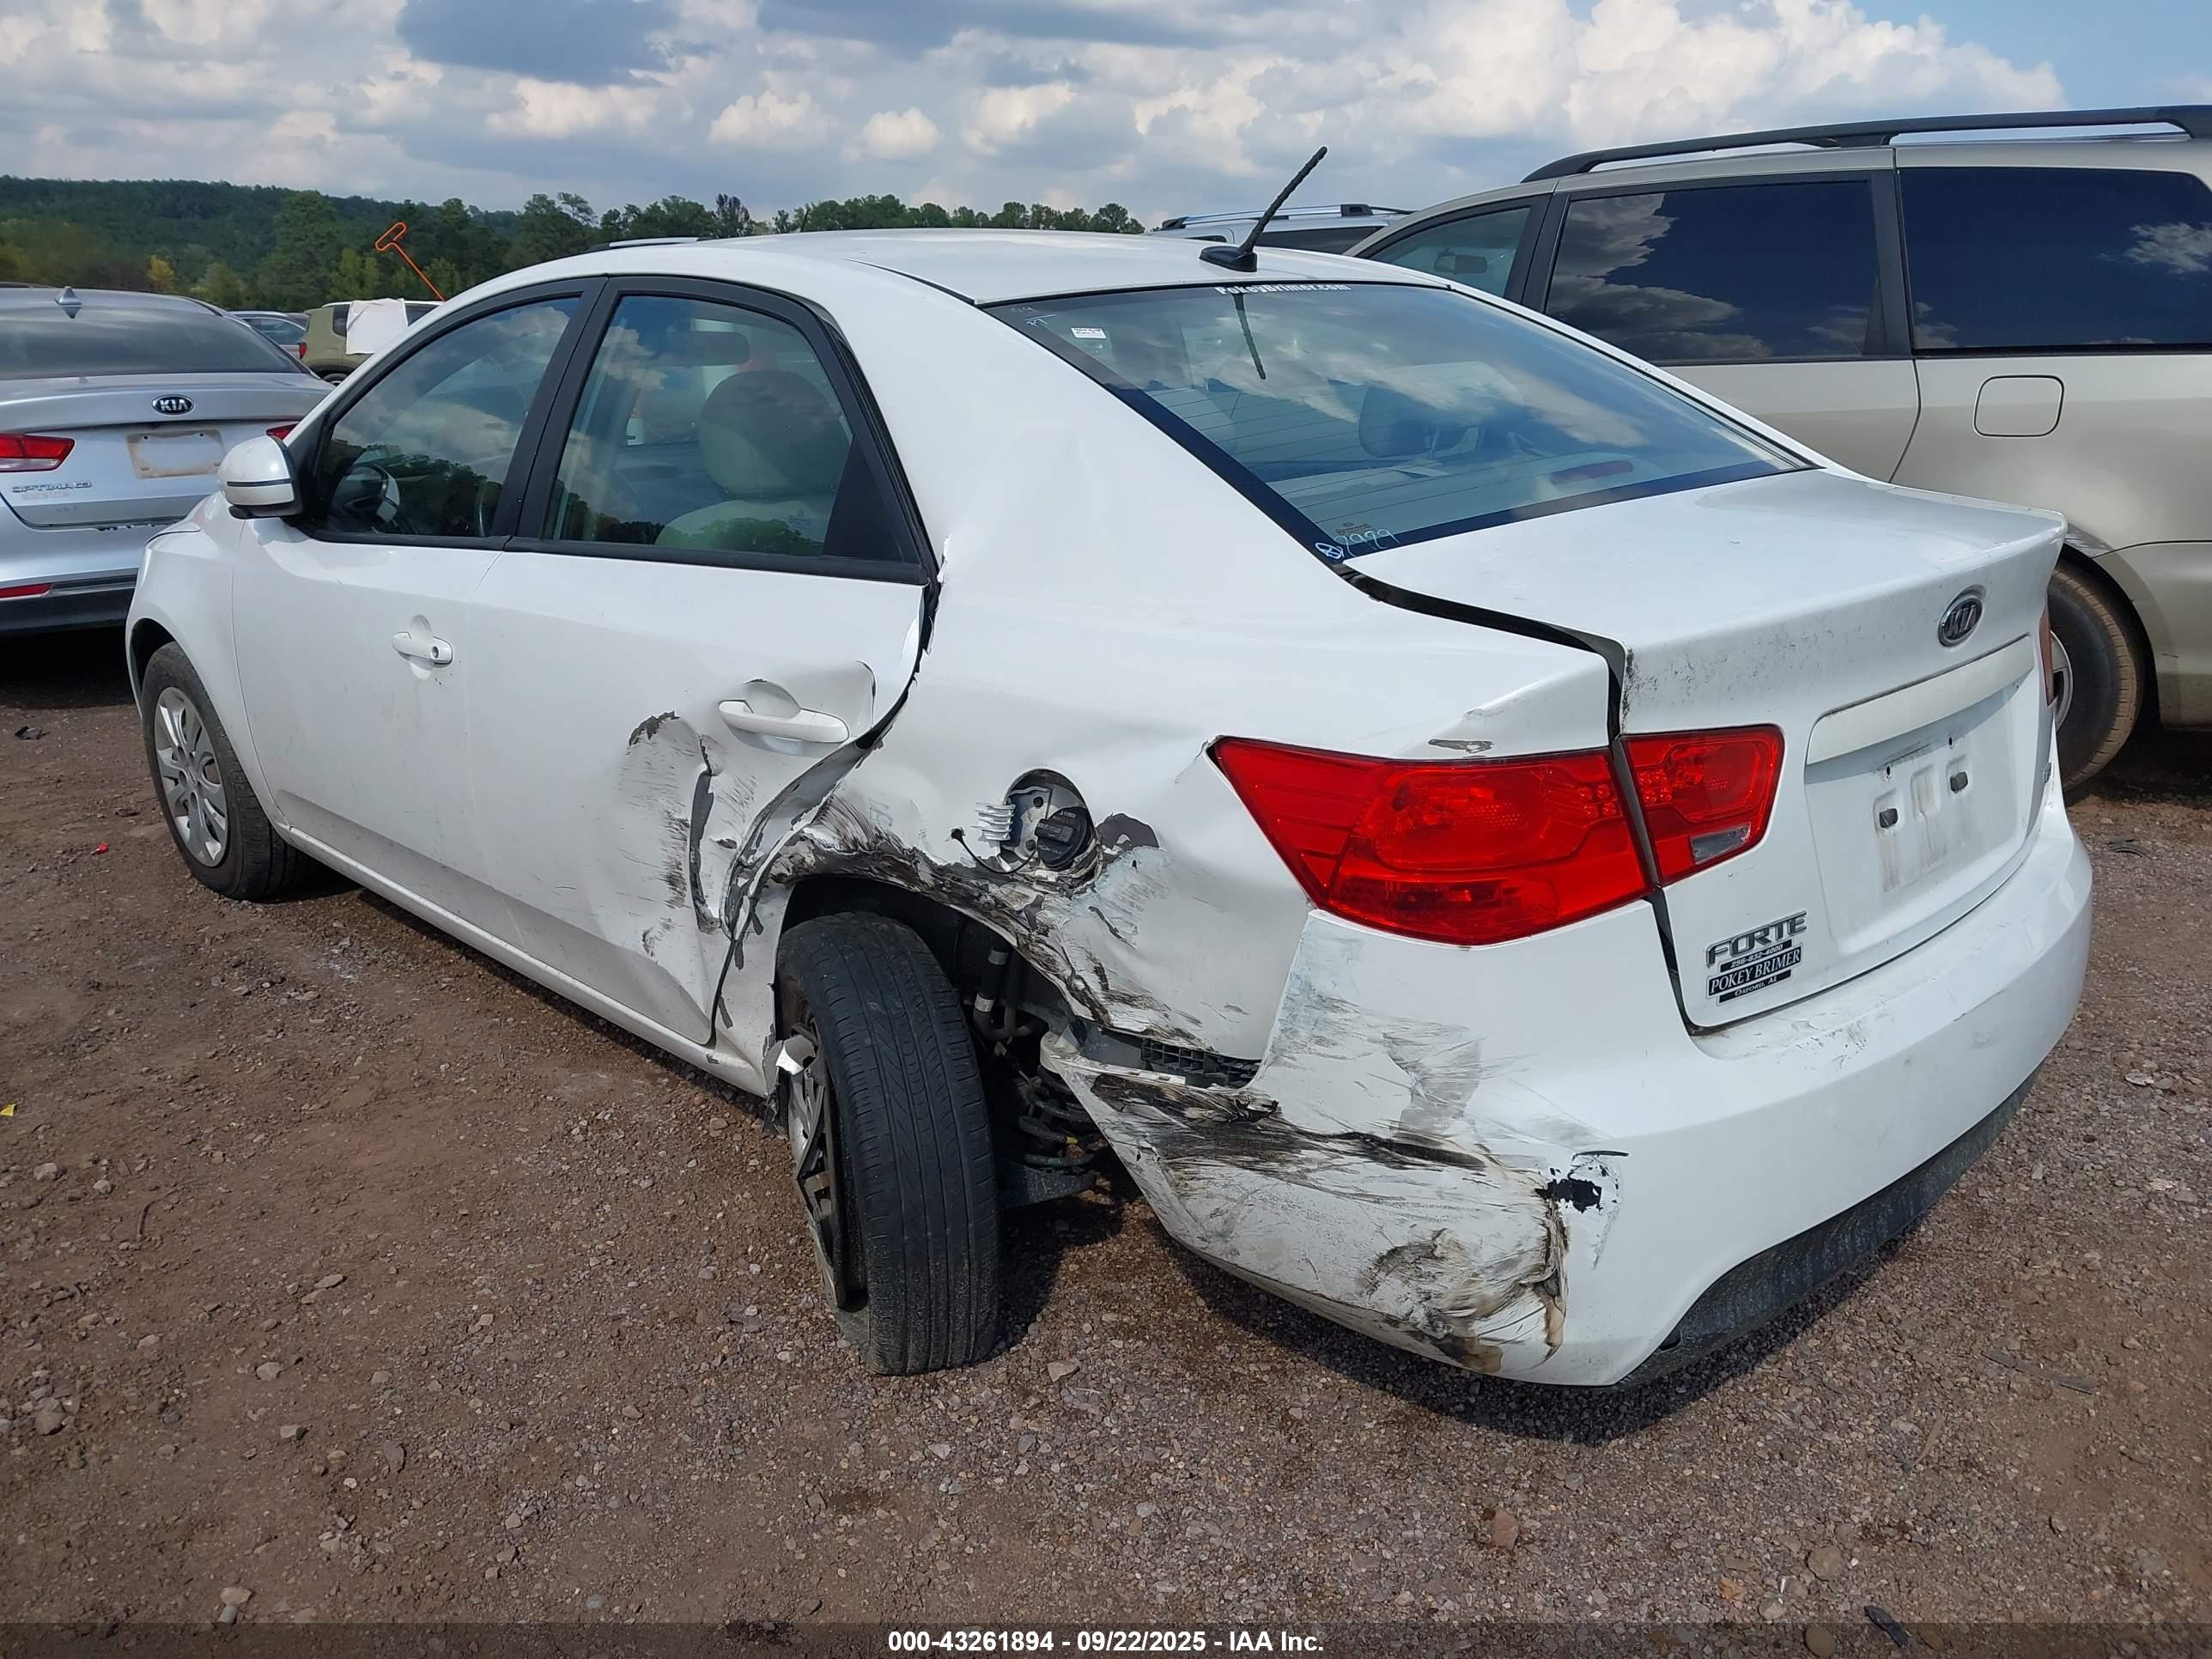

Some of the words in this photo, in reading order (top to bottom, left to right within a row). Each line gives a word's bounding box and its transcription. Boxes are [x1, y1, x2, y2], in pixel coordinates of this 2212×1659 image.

[157, 397, 191, 412] KIA
[1942, 603, 1980, 638] KIA
[1705, 910, 1807, 969] FORTE
[1730, 944, 1784, 969] 256-832-4000
[1710, 967, 1753, 994] POKEY
[1754, 948, 1801, 979] BRIMER
